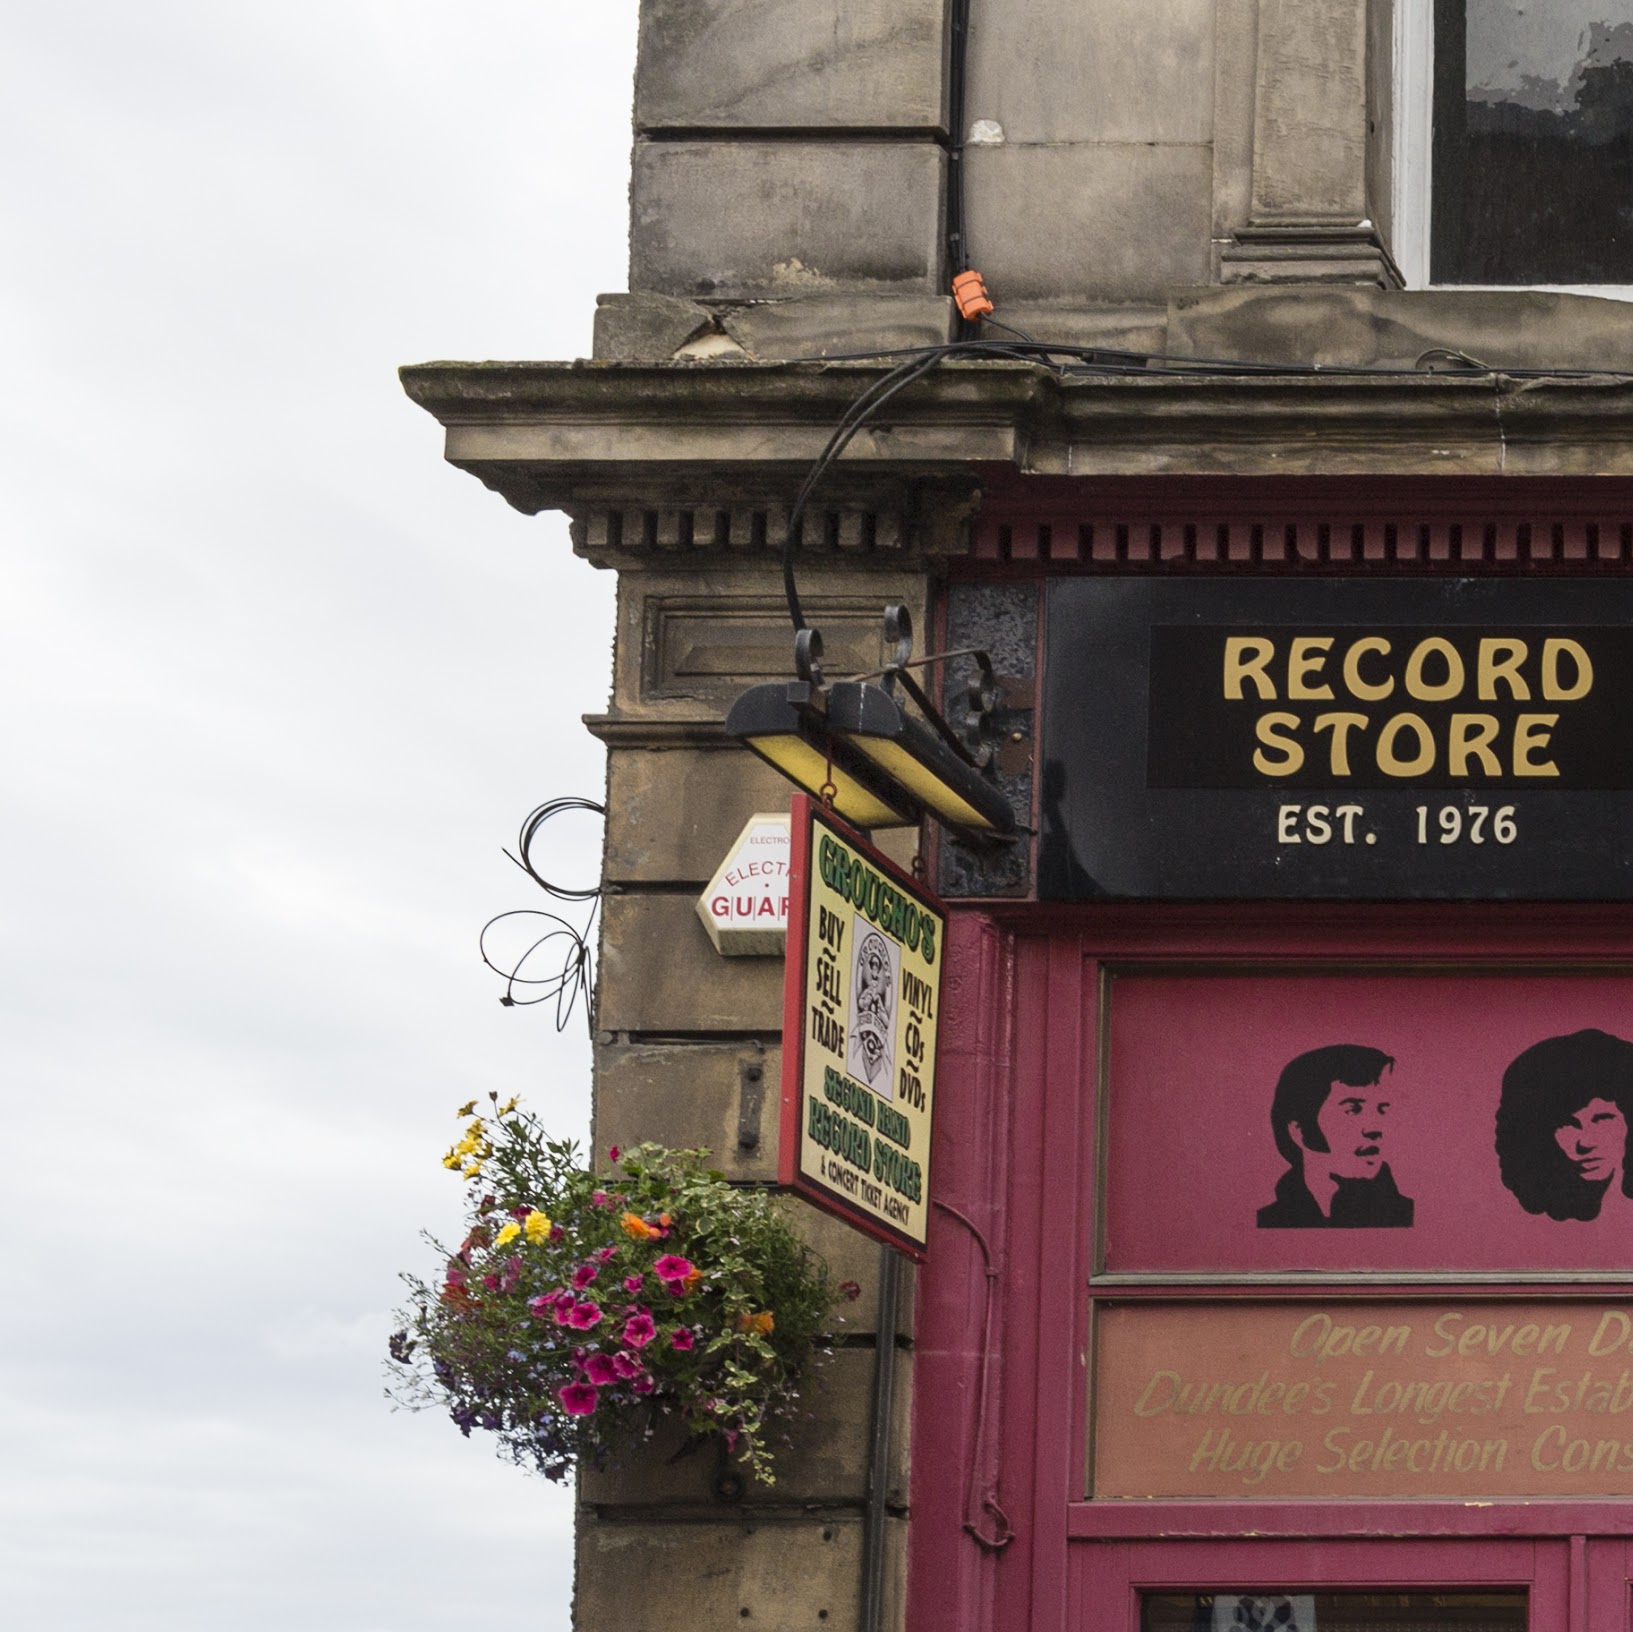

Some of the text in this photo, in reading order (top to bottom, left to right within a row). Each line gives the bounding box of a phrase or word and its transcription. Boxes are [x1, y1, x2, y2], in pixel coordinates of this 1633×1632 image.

[1223, 637, 1593, 701] RECORD
[1253, 712, 1560, 777] STORE
[1277, 805, 1517, 844] EST. 1976
[725, 861, 791, 887] ELECT
[819, 835, 936, 964] GROUCHO'S
[819, 905, 845, 953] BUY
[816, 957, 841, 1008] SELL
[902, 968, 932, 1020] VINYL
[812, 1006, 844, 1058] TRADE
[905, 1022, 925, 1062] CDs
[825, 1065, 910, 1149] SECOND HAND
[900, 1072, 926, 1113] DVDs
[808, 1096, 921, 1206] RECORD STORE
[828, 1160, 859, 1198] CONCERT
[861, 1176, 882, 1210] TICKET
[884, 1187, 909, 1226] AGENCY
[1289, 1313, 1412, 1368] Open
[1424, 1312, 1571, 1358] Seven
[1133, 1369, 1338, 1417] Dundee's
[1350, 1370, 1511, 1424] Longest
[1187, 1427, 1302, 1485] Huge
[1316, 1425, 1507, 1474] Selection
